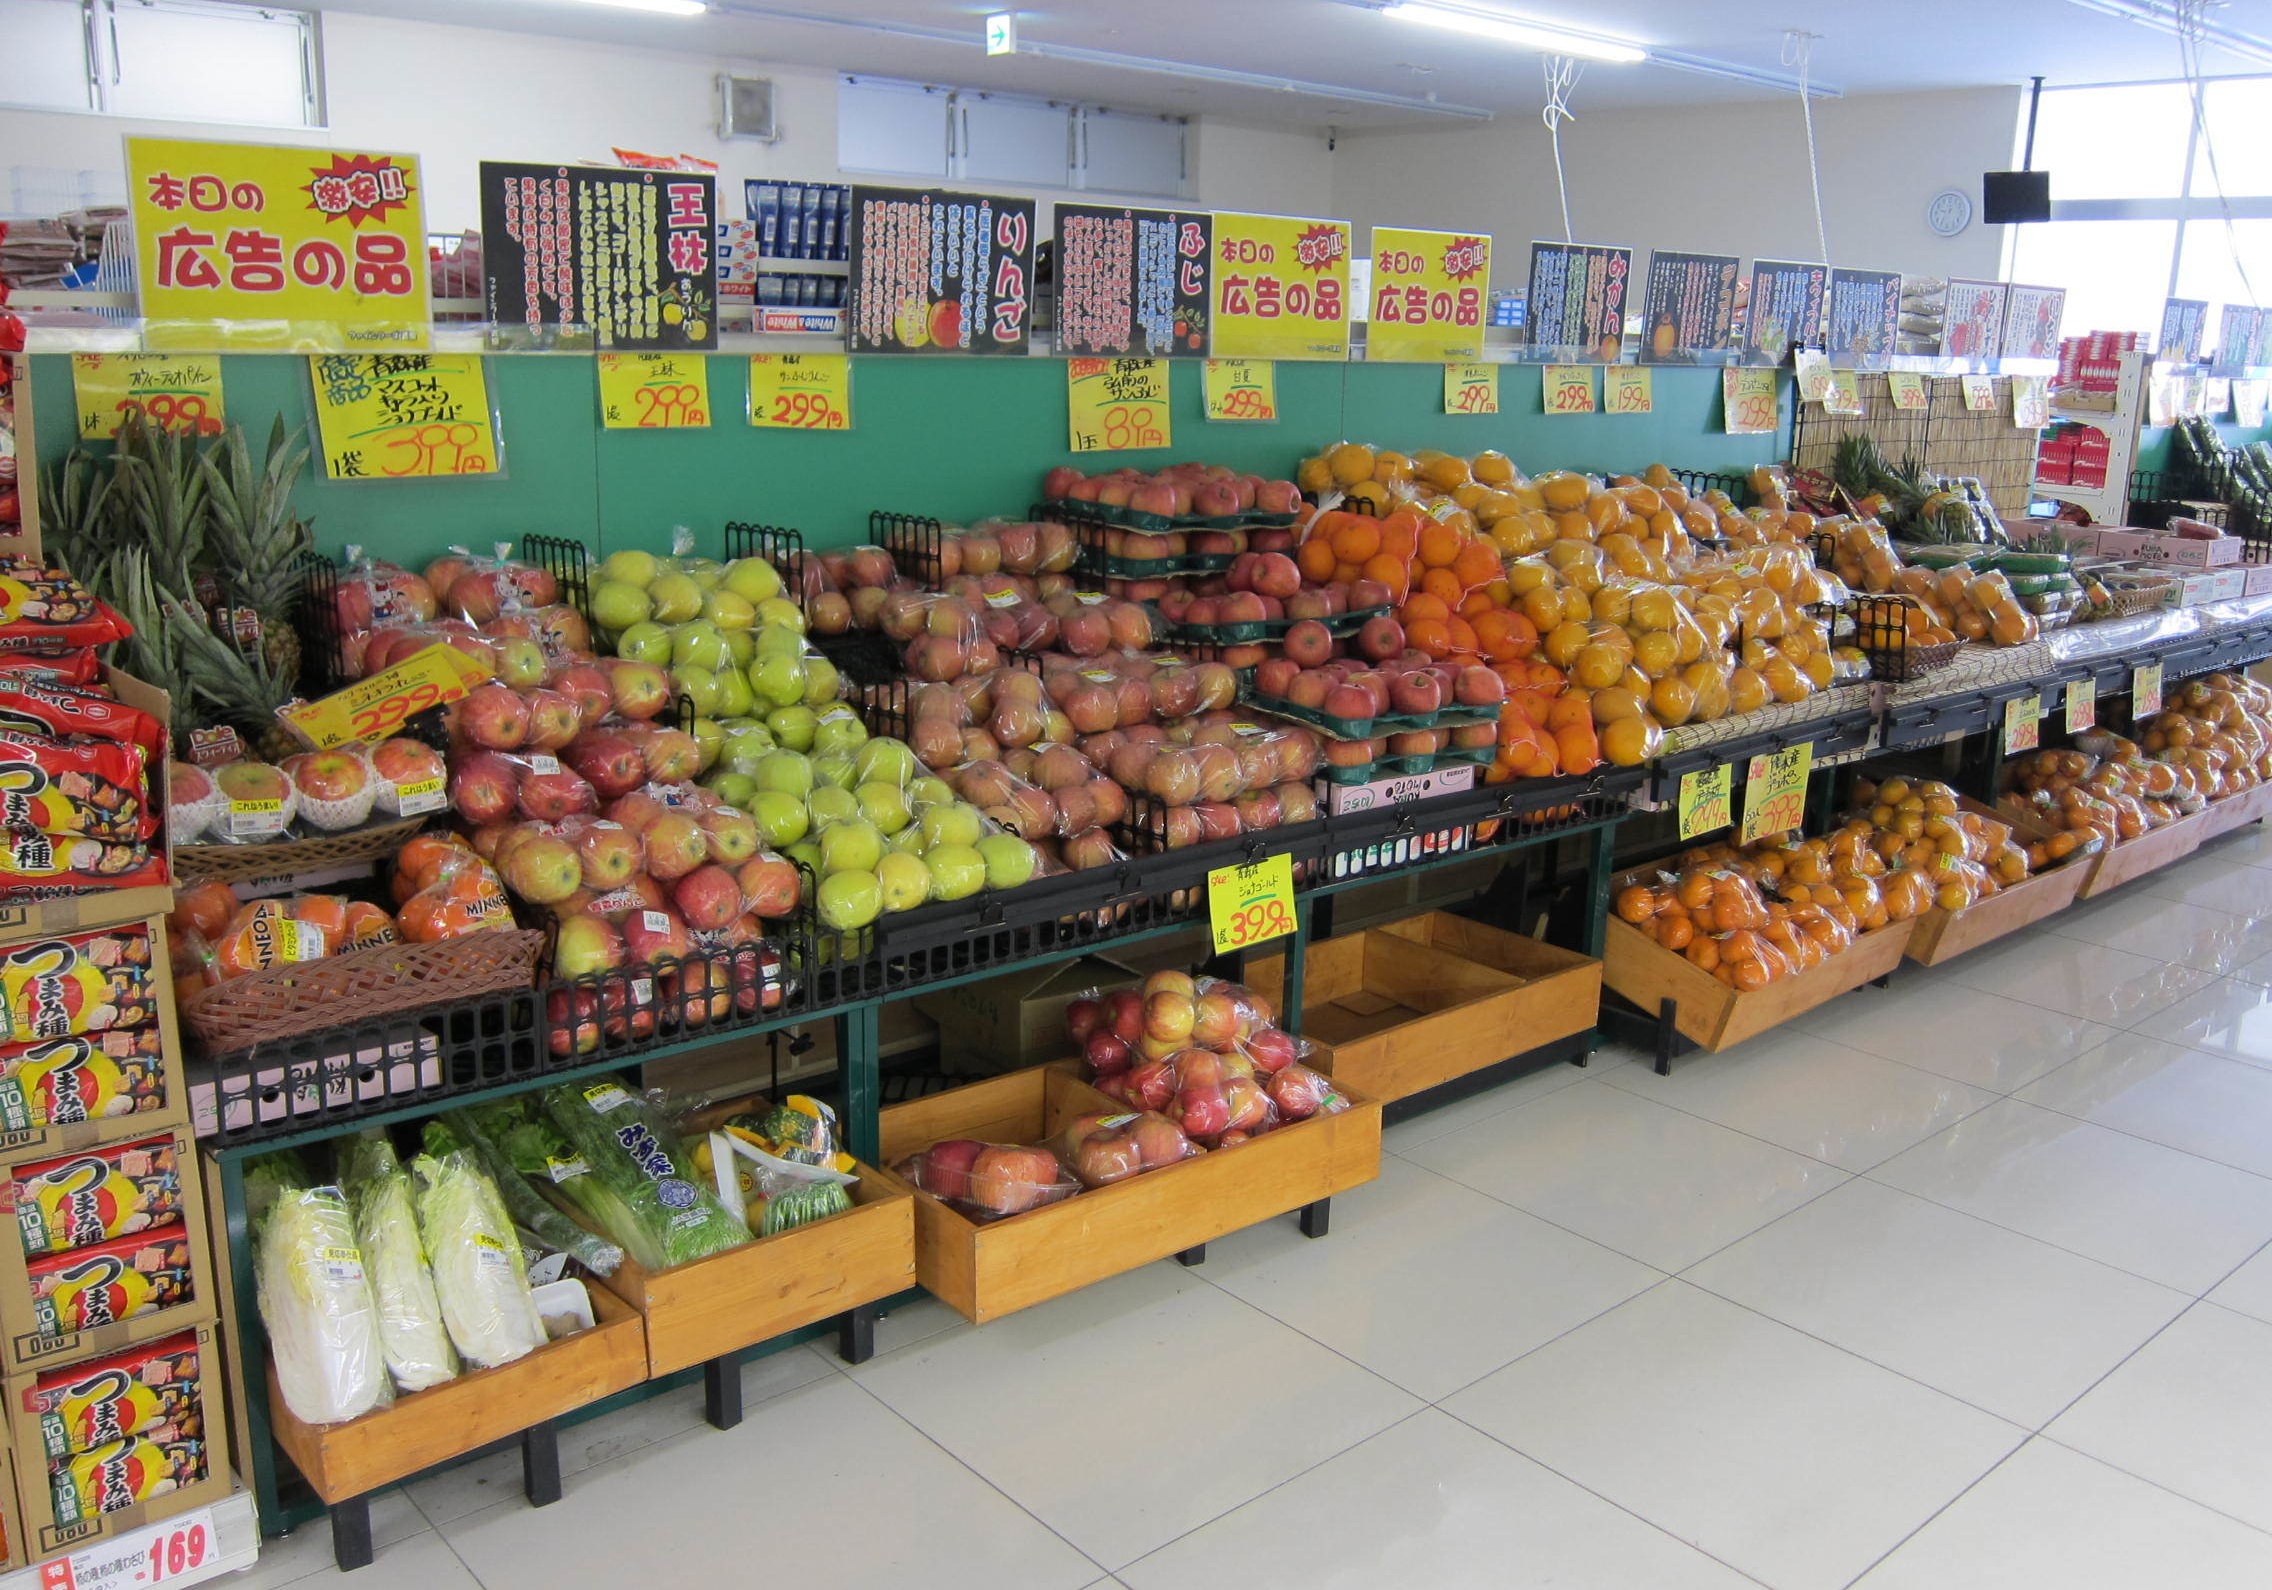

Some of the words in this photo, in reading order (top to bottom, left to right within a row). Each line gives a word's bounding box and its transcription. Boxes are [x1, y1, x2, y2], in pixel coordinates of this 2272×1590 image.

[148, 171, 265, 214] 本日の
[666, 183, 708, 276] 王林
[1220, 237, 1275, 264] 本日の
[156, 224, 414, 296] 広告の品
[993, 212, 1027, 342] りんご
[1179, 222, 1206, 295] ふじ
[1378, 250, 1425, 274] 本日の
[1220, 274, 1342, 321] 広告の品
[1375, 283, 1480, 327] 広告の品
[1602, 250, 1628, 335] みかん
[767, 314, 799, 329] White
[804, 315, 834, 330] White
[771, 391, 843, 429] 299円
[1223, 389, 1273, 419] 299円
[1456, 385, 1496, 413] 299円
[1556, 385, 1594, 411] 299円
[1104, 406, 1163, 450] 89円
[1230, 900, 1294, 945] 399円
[9, 940, 77, 1039] つまみ種
[18, 1212, 43, 1231] 10
[44, 1156, 110, 1248] つまみ種
[42, 1423, 65, 1440] 10
[56, 1485, 76, 1503] 10
[149, 1524, 206, 1582] 169
